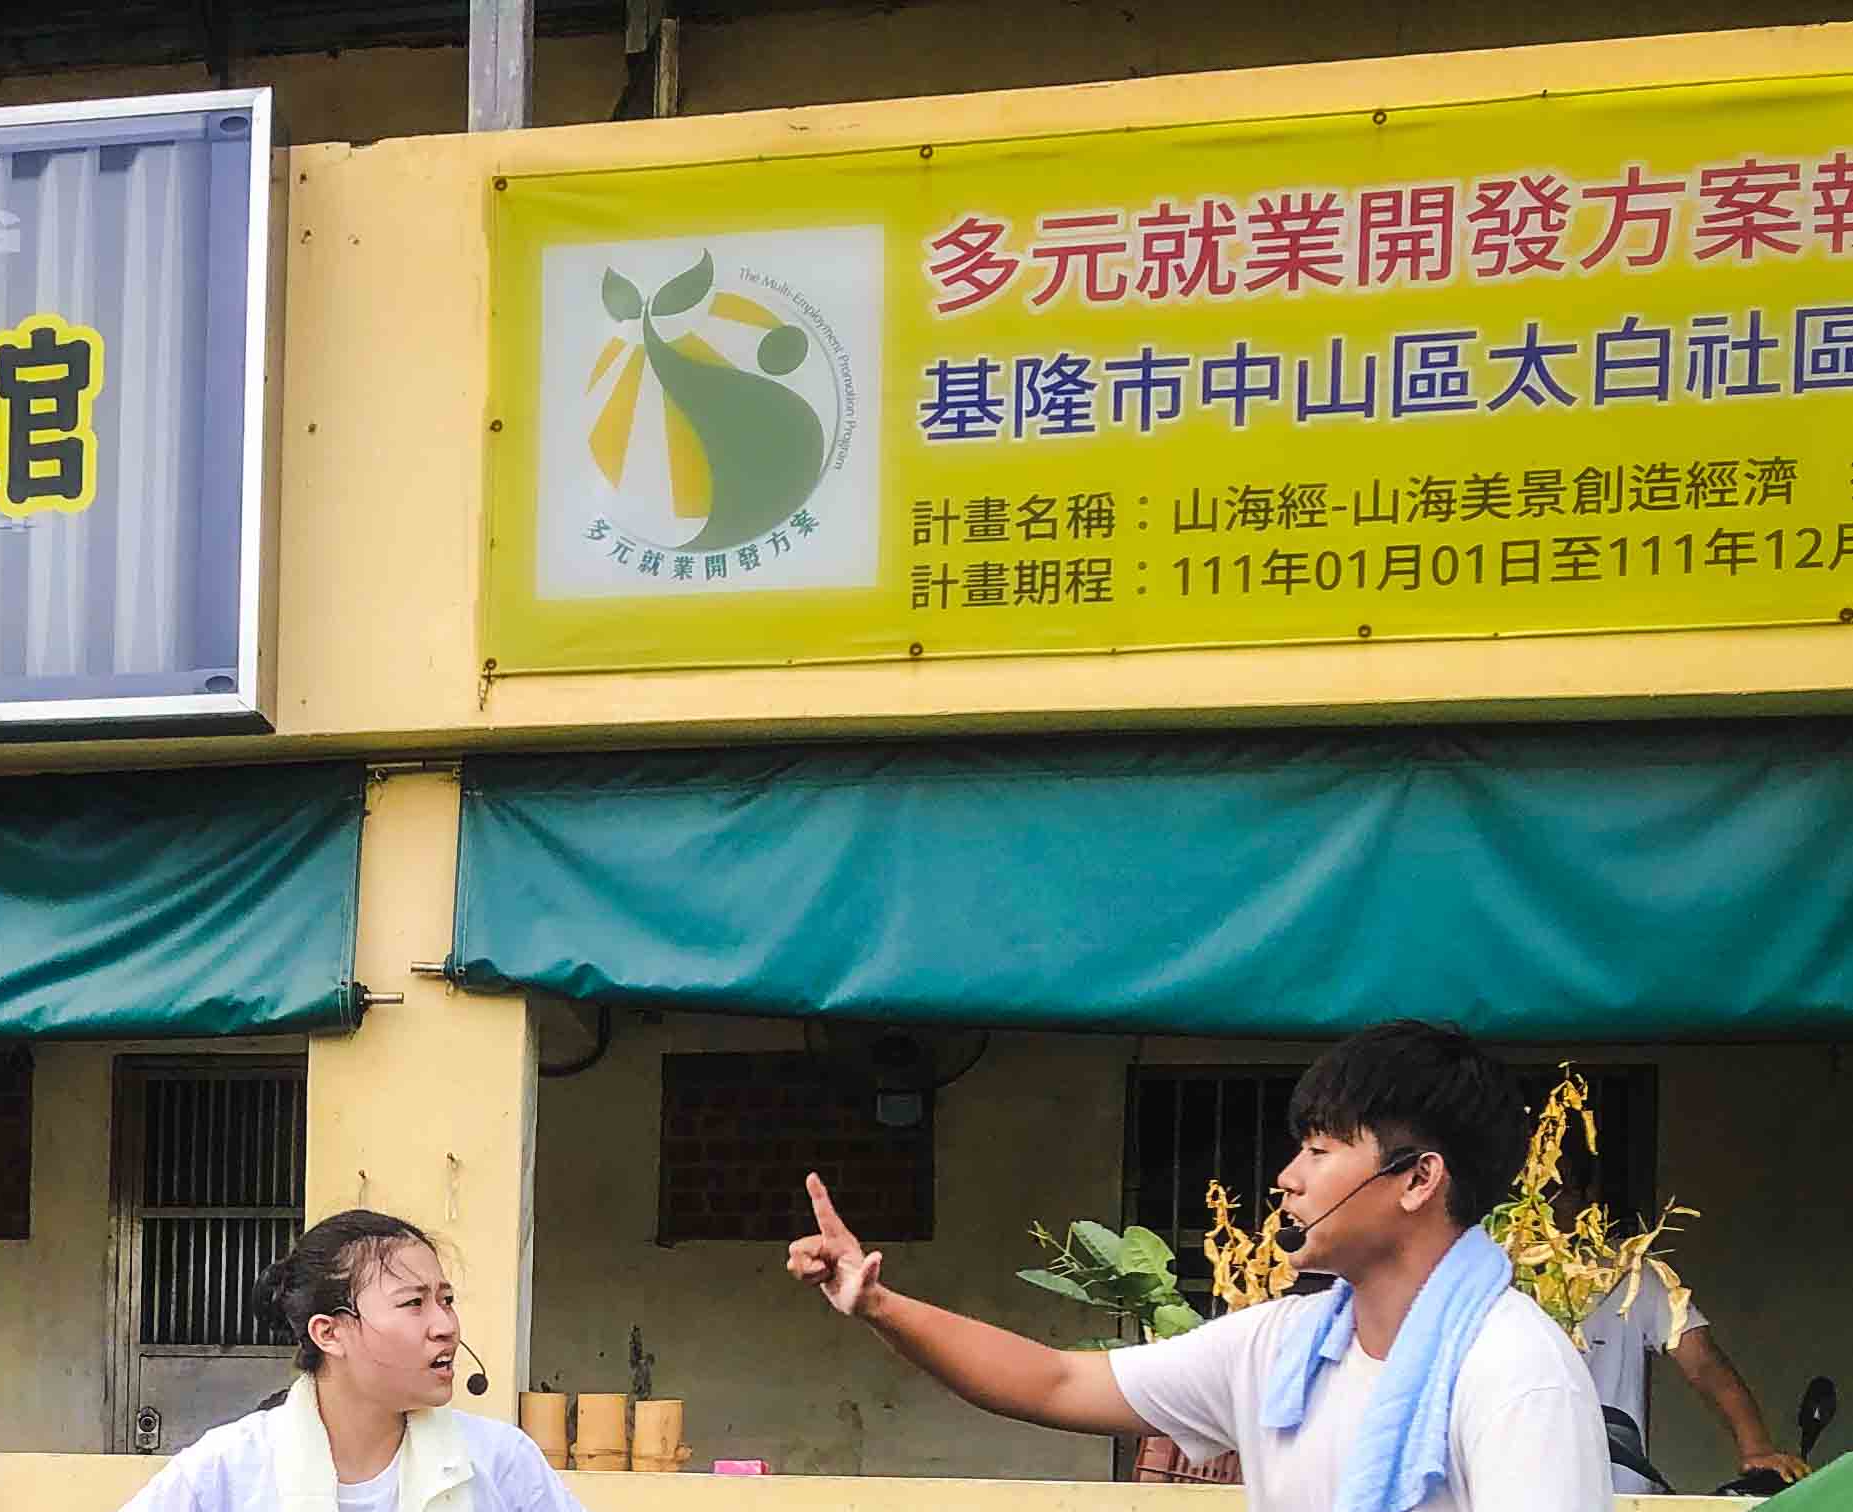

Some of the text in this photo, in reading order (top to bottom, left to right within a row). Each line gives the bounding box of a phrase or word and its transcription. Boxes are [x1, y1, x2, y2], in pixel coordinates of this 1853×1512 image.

[919, 304, 1853, 441] 基隆市中山區太白社區
[582, 507, 821, 581] 多元就業開發方案
